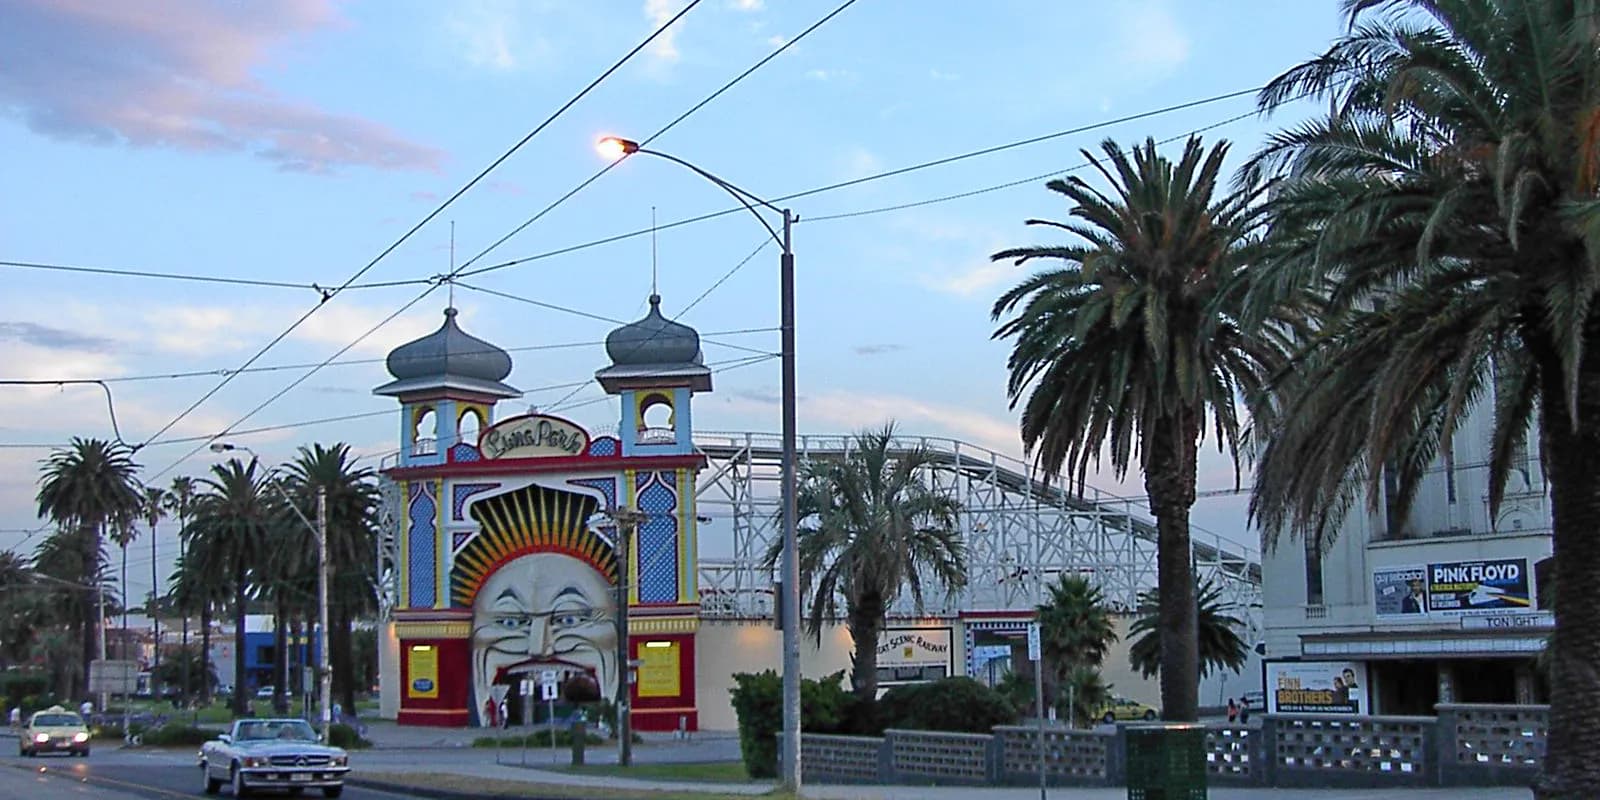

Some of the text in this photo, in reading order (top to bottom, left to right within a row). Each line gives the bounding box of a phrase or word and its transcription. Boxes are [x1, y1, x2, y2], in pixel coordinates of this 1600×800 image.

[487, 420, 581, 458] Luna Park
[1434, 567, 1469, 583] PINK
[1471, 564, 1519, 581] FLOYD
[1486, 616, 1539, 627] TONIGHT
[890, 634, 915, 649] SCENIC
[916, 636, 948, 652] RAILWAY
[1278, 690, 1333, 704] BROTHERS
